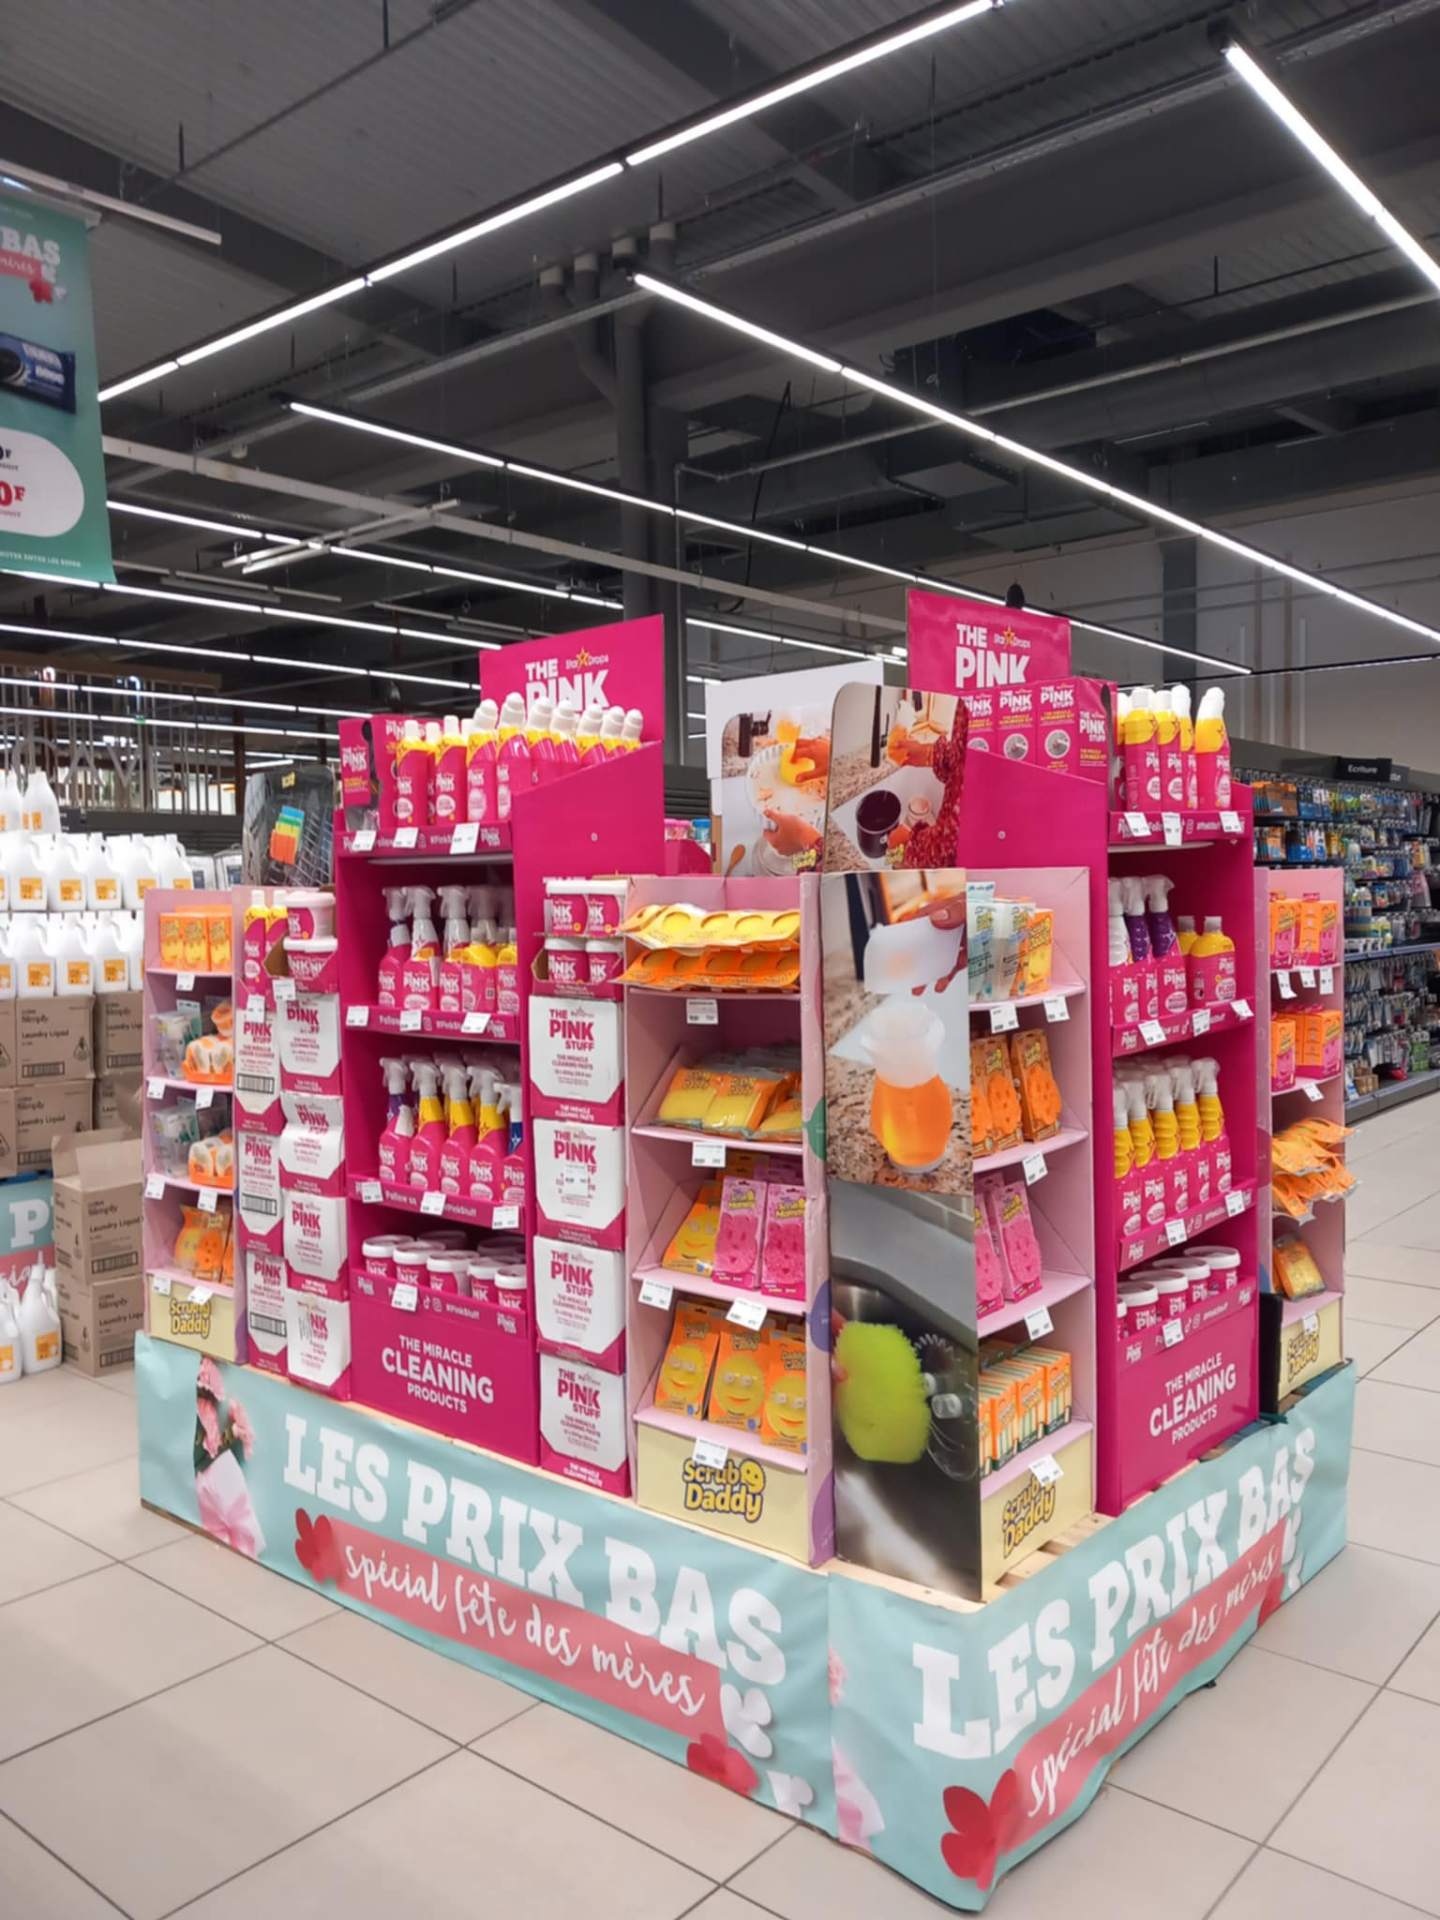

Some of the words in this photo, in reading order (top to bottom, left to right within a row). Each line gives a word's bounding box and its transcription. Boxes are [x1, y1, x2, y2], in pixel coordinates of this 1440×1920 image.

[956, 624, 987, 648] THE
[525, 658, 558, 681] THE
[956, 646, 1030, 688] PINK
[1000, 693, 1032, 709] PINK
[1040, 689, 1073, 705] PINK
[1079, 718, 1105, 735] PINK
[287, 1007, 320, 1026] PINK
[549, 1008, 568, 1020] THE
[243, 1021, 272, 1037] PINK
[549, 1019, 595, 1042] PINK
[565, 1040, 595, 1052] STUFF
[298, 1110, 329, 1128] PINK
[554, 1130, 571, 1141] THE
[245, 1142, 272, 1158] PINK
[554, 1140, 597, 1165] PINK
[90, 1222, 118, 1233] Laundry
[292, 1209, 321, 1230] PINK
[551, 1249, 569, 1262] THE
[254, 1260, 281, 1279] PINK
[551, 1261, 593, 1288] PINK
[565, 1283, 593, 1298] STUFF
[171, 1315, 212, 1340] Daddy
[399, 1334, 421, 1353] THE
[423, 1342, 472, 1368] MIRACLE
[381, 1347, 494, 1404] CLEANING
[558, 1367, 576, 1382] THE
[1165, 1376, 1184, 1396] THE
[1185, 1352, 1223, 1384] MIRACLE
[407, 1382, 468, 1414] PRODUCTS
[557, 1379, 601, 1410] PINK
[1150, 1363, 1237, 1438] CLEANING
[572, 1402, 601, 1420] STUFF
[1171, 1404, 1218, 1445] PRODUCTS
[682, 1457, 742, 1486] Scrub
[684, 1481, 763, 1523] Daddy
[1003, 1487, 1057, 1560] Daddy
[283, 1413, 390, 1523] LES
[402, 1460, 586, 1607] PRIX
[604, 1537, 786, 1685] BAS
[912, 1598, 1076, 1760] LES
[1088, 1489, 1230, 1671] PRIX
[1237, 1427, 1315, 1560] BAS
[344, 1543, 447, 1614] spécial
[453, 1574, 517, 1639] fête
[525, 1603, 582, 1667] des
[591, 1642, 706, 1717] mères
[1027, 1664, 1129, 1819] spécial
[1132, 1628, 1174, 1722] fête
[1178, 1598, 1222, 1656] des
